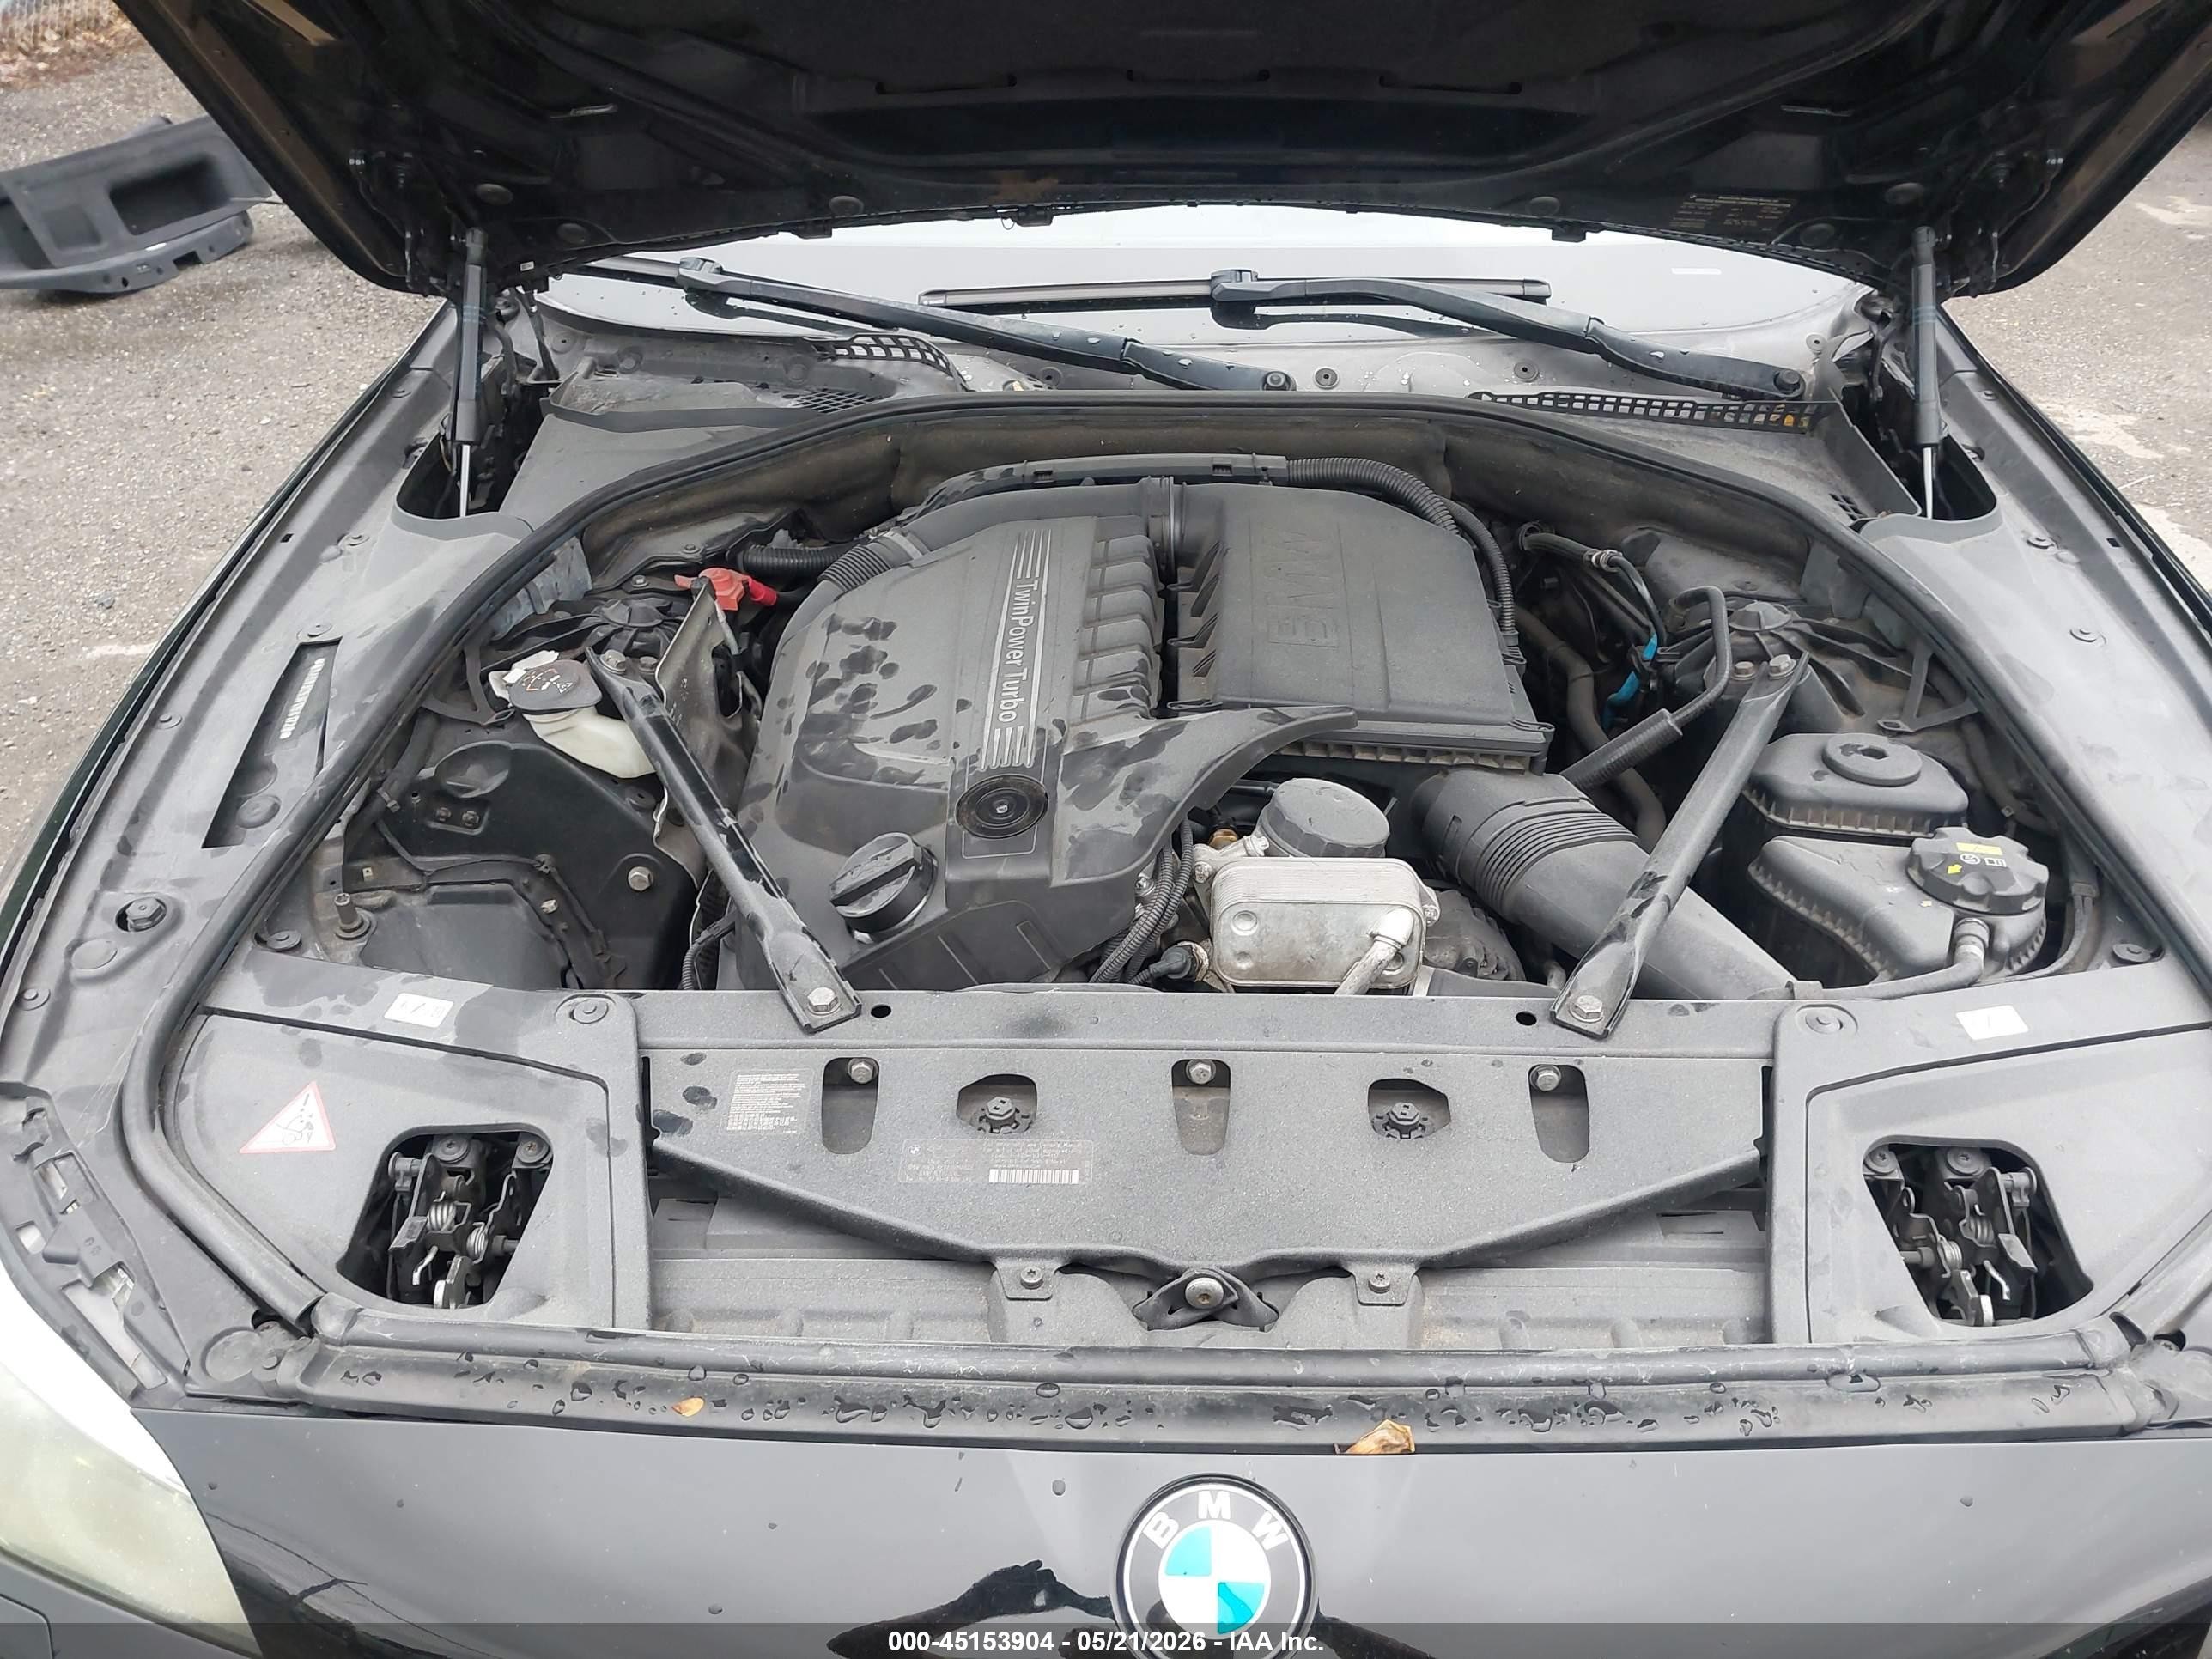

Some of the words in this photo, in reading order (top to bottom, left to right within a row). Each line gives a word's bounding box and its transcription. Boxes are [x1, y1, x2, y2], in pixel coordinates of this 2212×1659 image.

[1005, 579, 1039, 667] TwinPower
[998, 667, 1028, 723] Turbo
[1142, 1490, 1289, 1551] BMW
